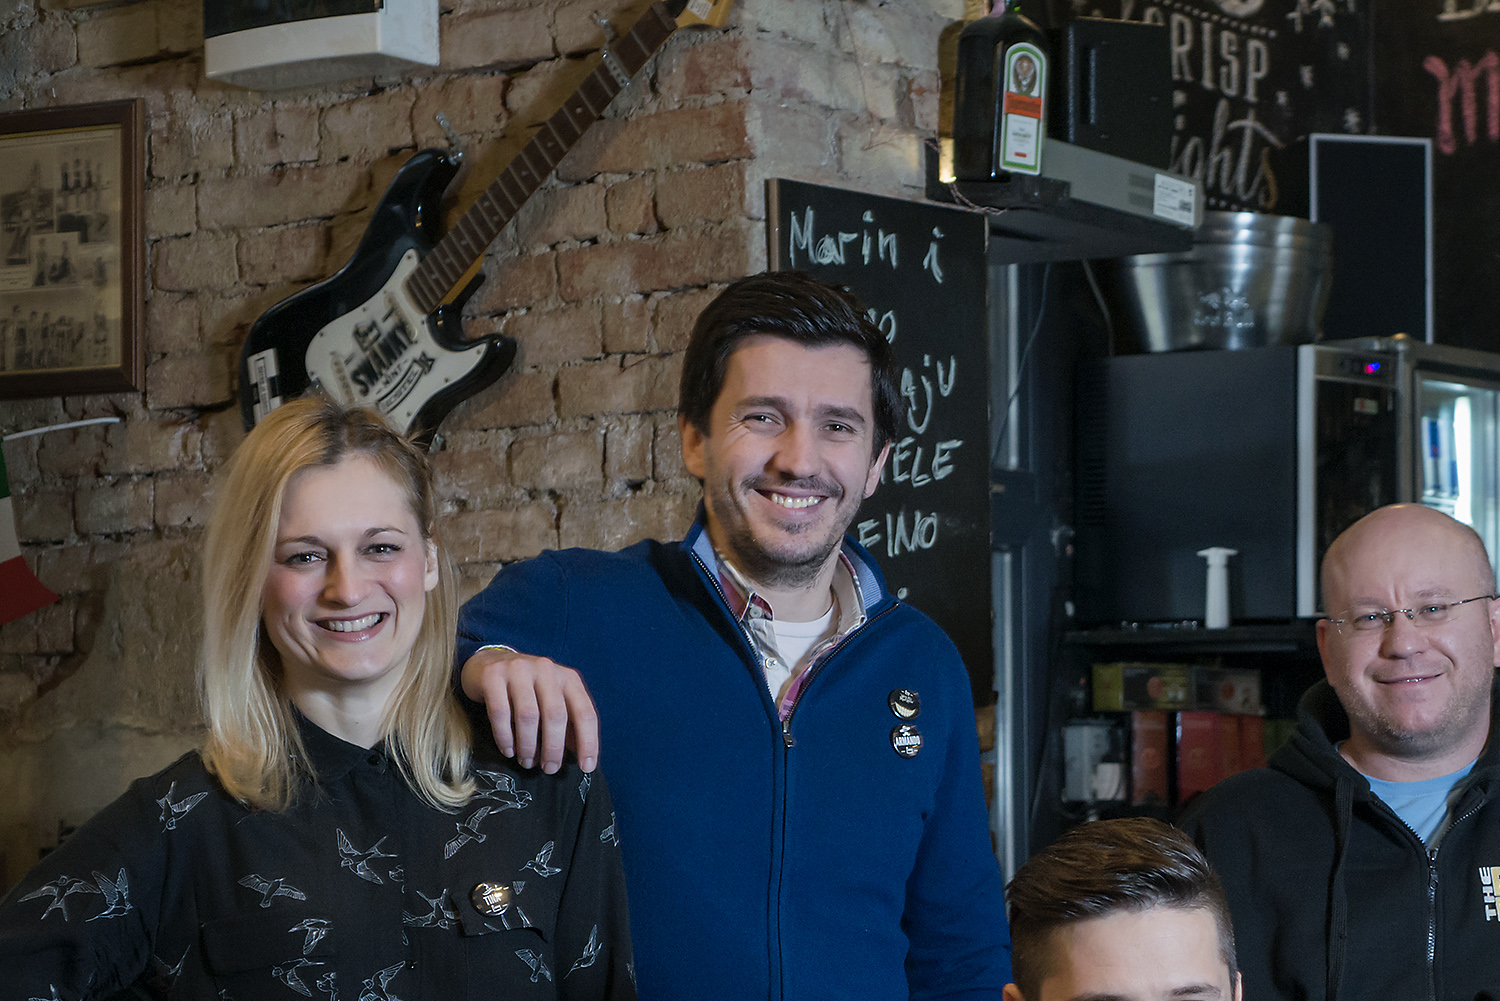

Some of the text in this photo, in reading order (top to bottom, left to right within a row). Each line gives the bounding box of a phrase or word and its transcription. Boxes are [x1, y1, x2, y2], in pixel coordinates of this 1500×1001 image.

[788, 204, 898, 271] Marin
[352, 316, 419, 397] SWANKY
[1478, 866, 1497, 922] THE
